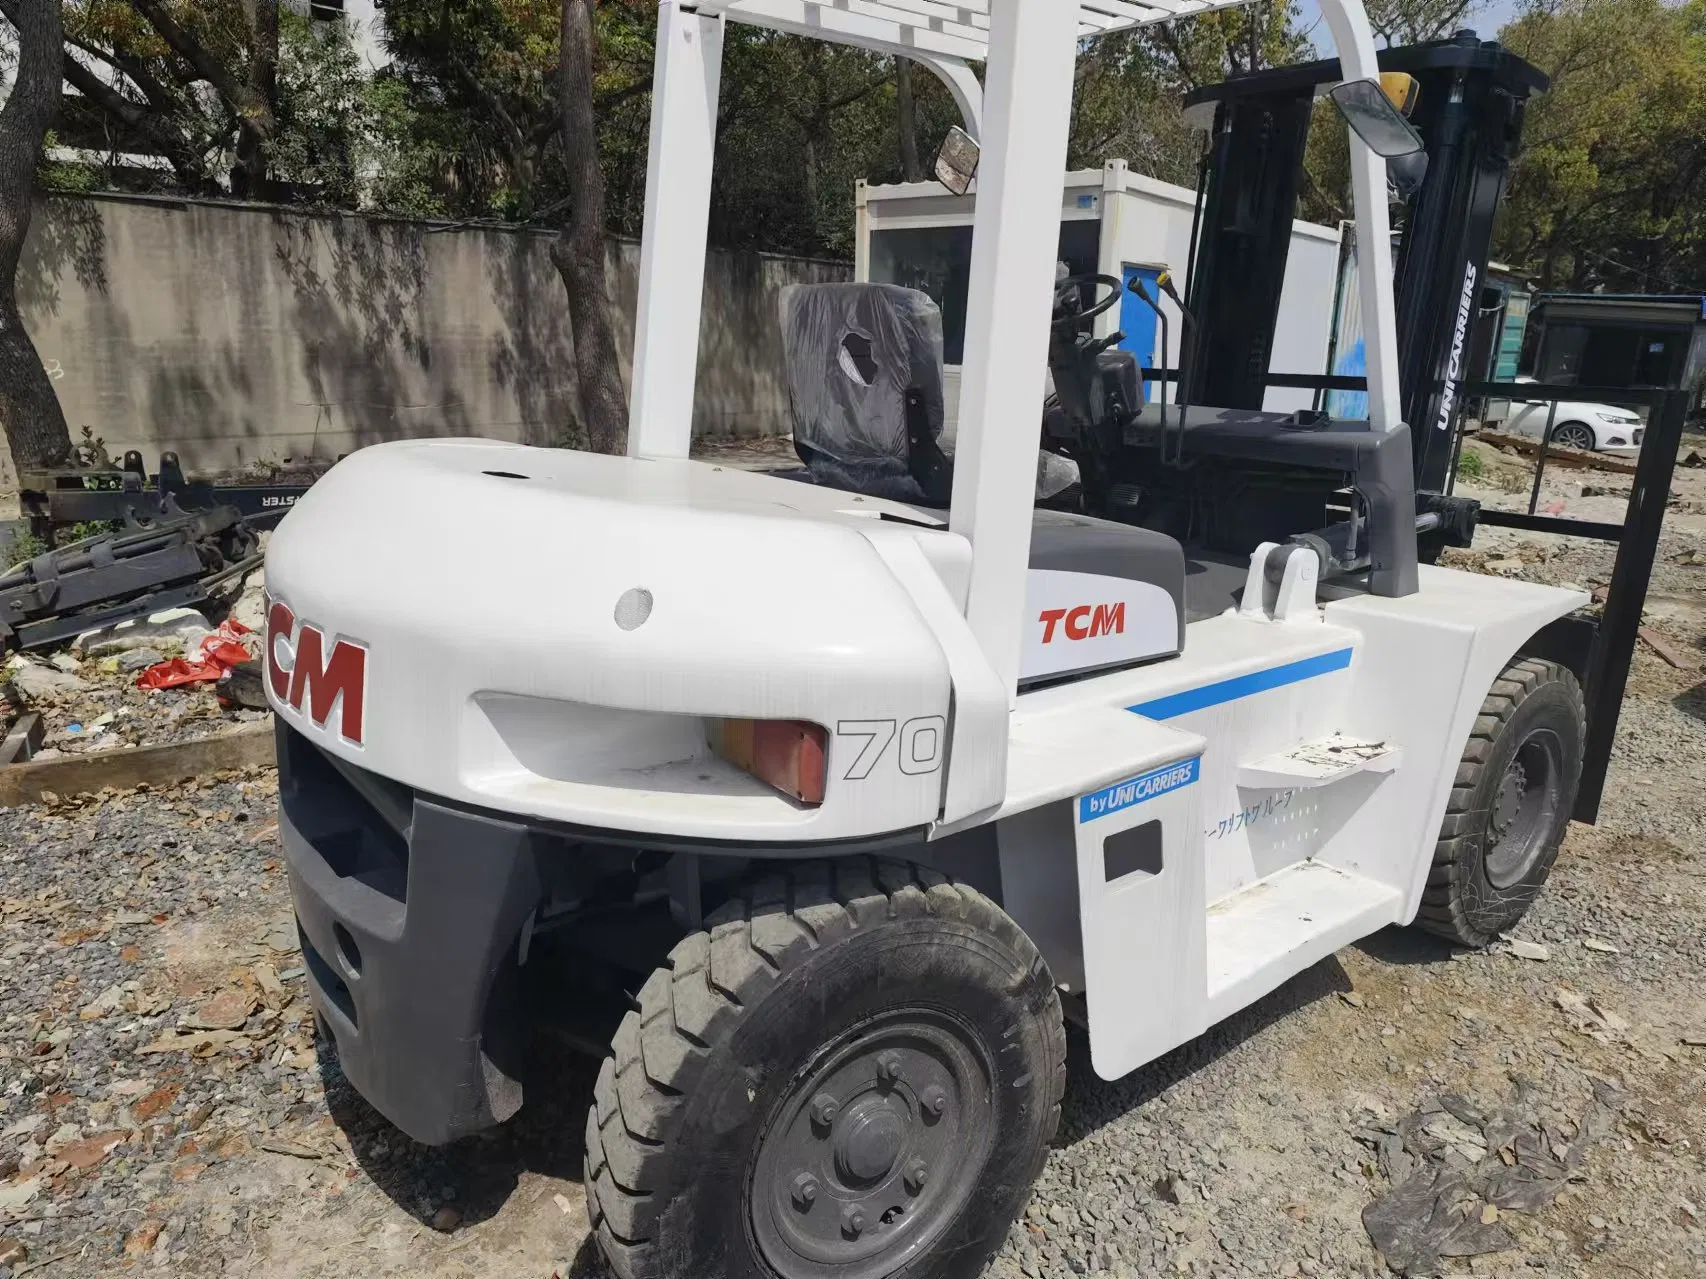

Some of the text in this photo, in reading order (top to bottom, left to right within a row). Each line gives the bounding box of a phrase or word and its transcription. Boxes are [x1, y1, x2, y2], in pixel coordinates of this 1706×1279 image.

[1038, 601, 1126, 645] TCM
[264, 587, 368, 748] CM
[836, 714, 946, 781] 70
[1089, 796, 1107, 813] by
